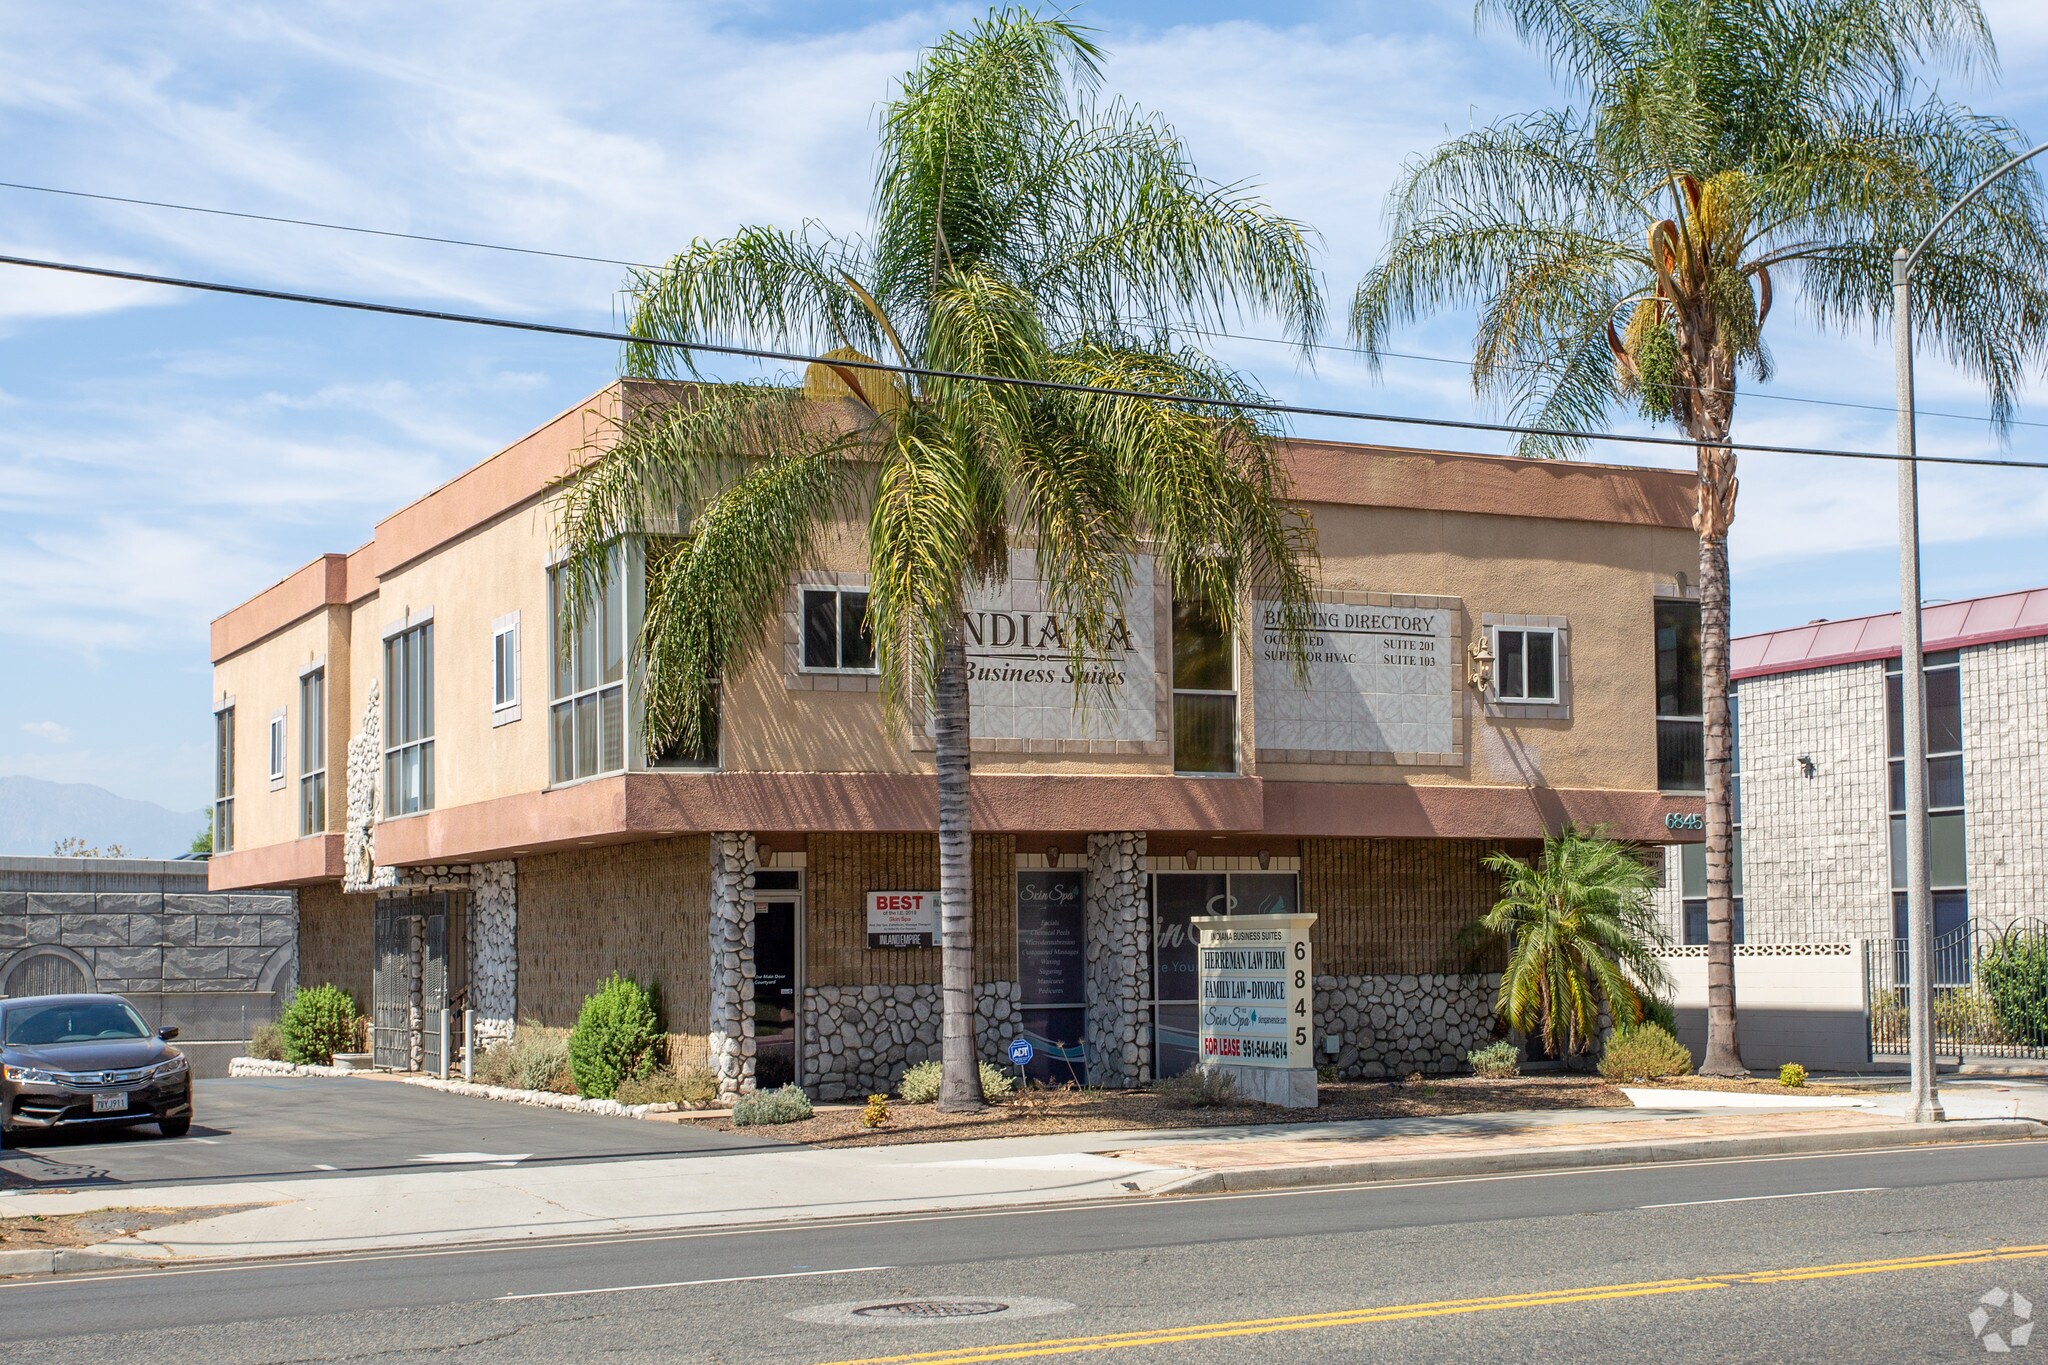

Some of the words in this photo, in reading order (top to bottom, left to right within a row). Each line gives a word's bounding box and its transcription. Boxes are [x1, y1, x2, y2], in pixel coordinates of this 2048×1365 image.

[963, 611, 1136, 651] NDIAA
[1345, 613, 1434, 632] DIRECTORY
[1383, 638, 1416, 650] SUITE
[1419, 641, 1434, 651] 201
[1325, 652, 1356, 663] HVAC
[1383, 653, 1417, 666] SUITE
[1419, 656, 1436, 667] 103
[966, 661, 1055, 683] Business
[1665, 812, 1704, 830] 6845
[876, 895, 923, 910] BEST
[1048, 884, 1074, 905] Spa
[879, 934, 900, 945] INLAND
[900, 934, 921, 945] EMPIRE
[1211, 931, 1232, 941] INDIANA
[1233, 931, 1261, 941] BUSINESS
[1261, 931, 1282, 941] SUITES
[1204, 951, 1246, 969] HERREMAN
[1247, 951, 1264, 970] LAW
[1265, 951, 1286, 970] FIRM
[1204, 980, 1231, 998] FAMILY
[1231, 980, 1247, 999] LAW
[1251, 980, 1286, 1000] DIVORCE
[1228, 1006, 1250, 1032] Spa
[1013, 1046, 1029, 1057] ADT
[1204, 1037, 1218, 1055] FOR
[1219, 1038, 1241, 1057] LEASE
[1242, 1040, 1288, 1059] 951-544-4614
